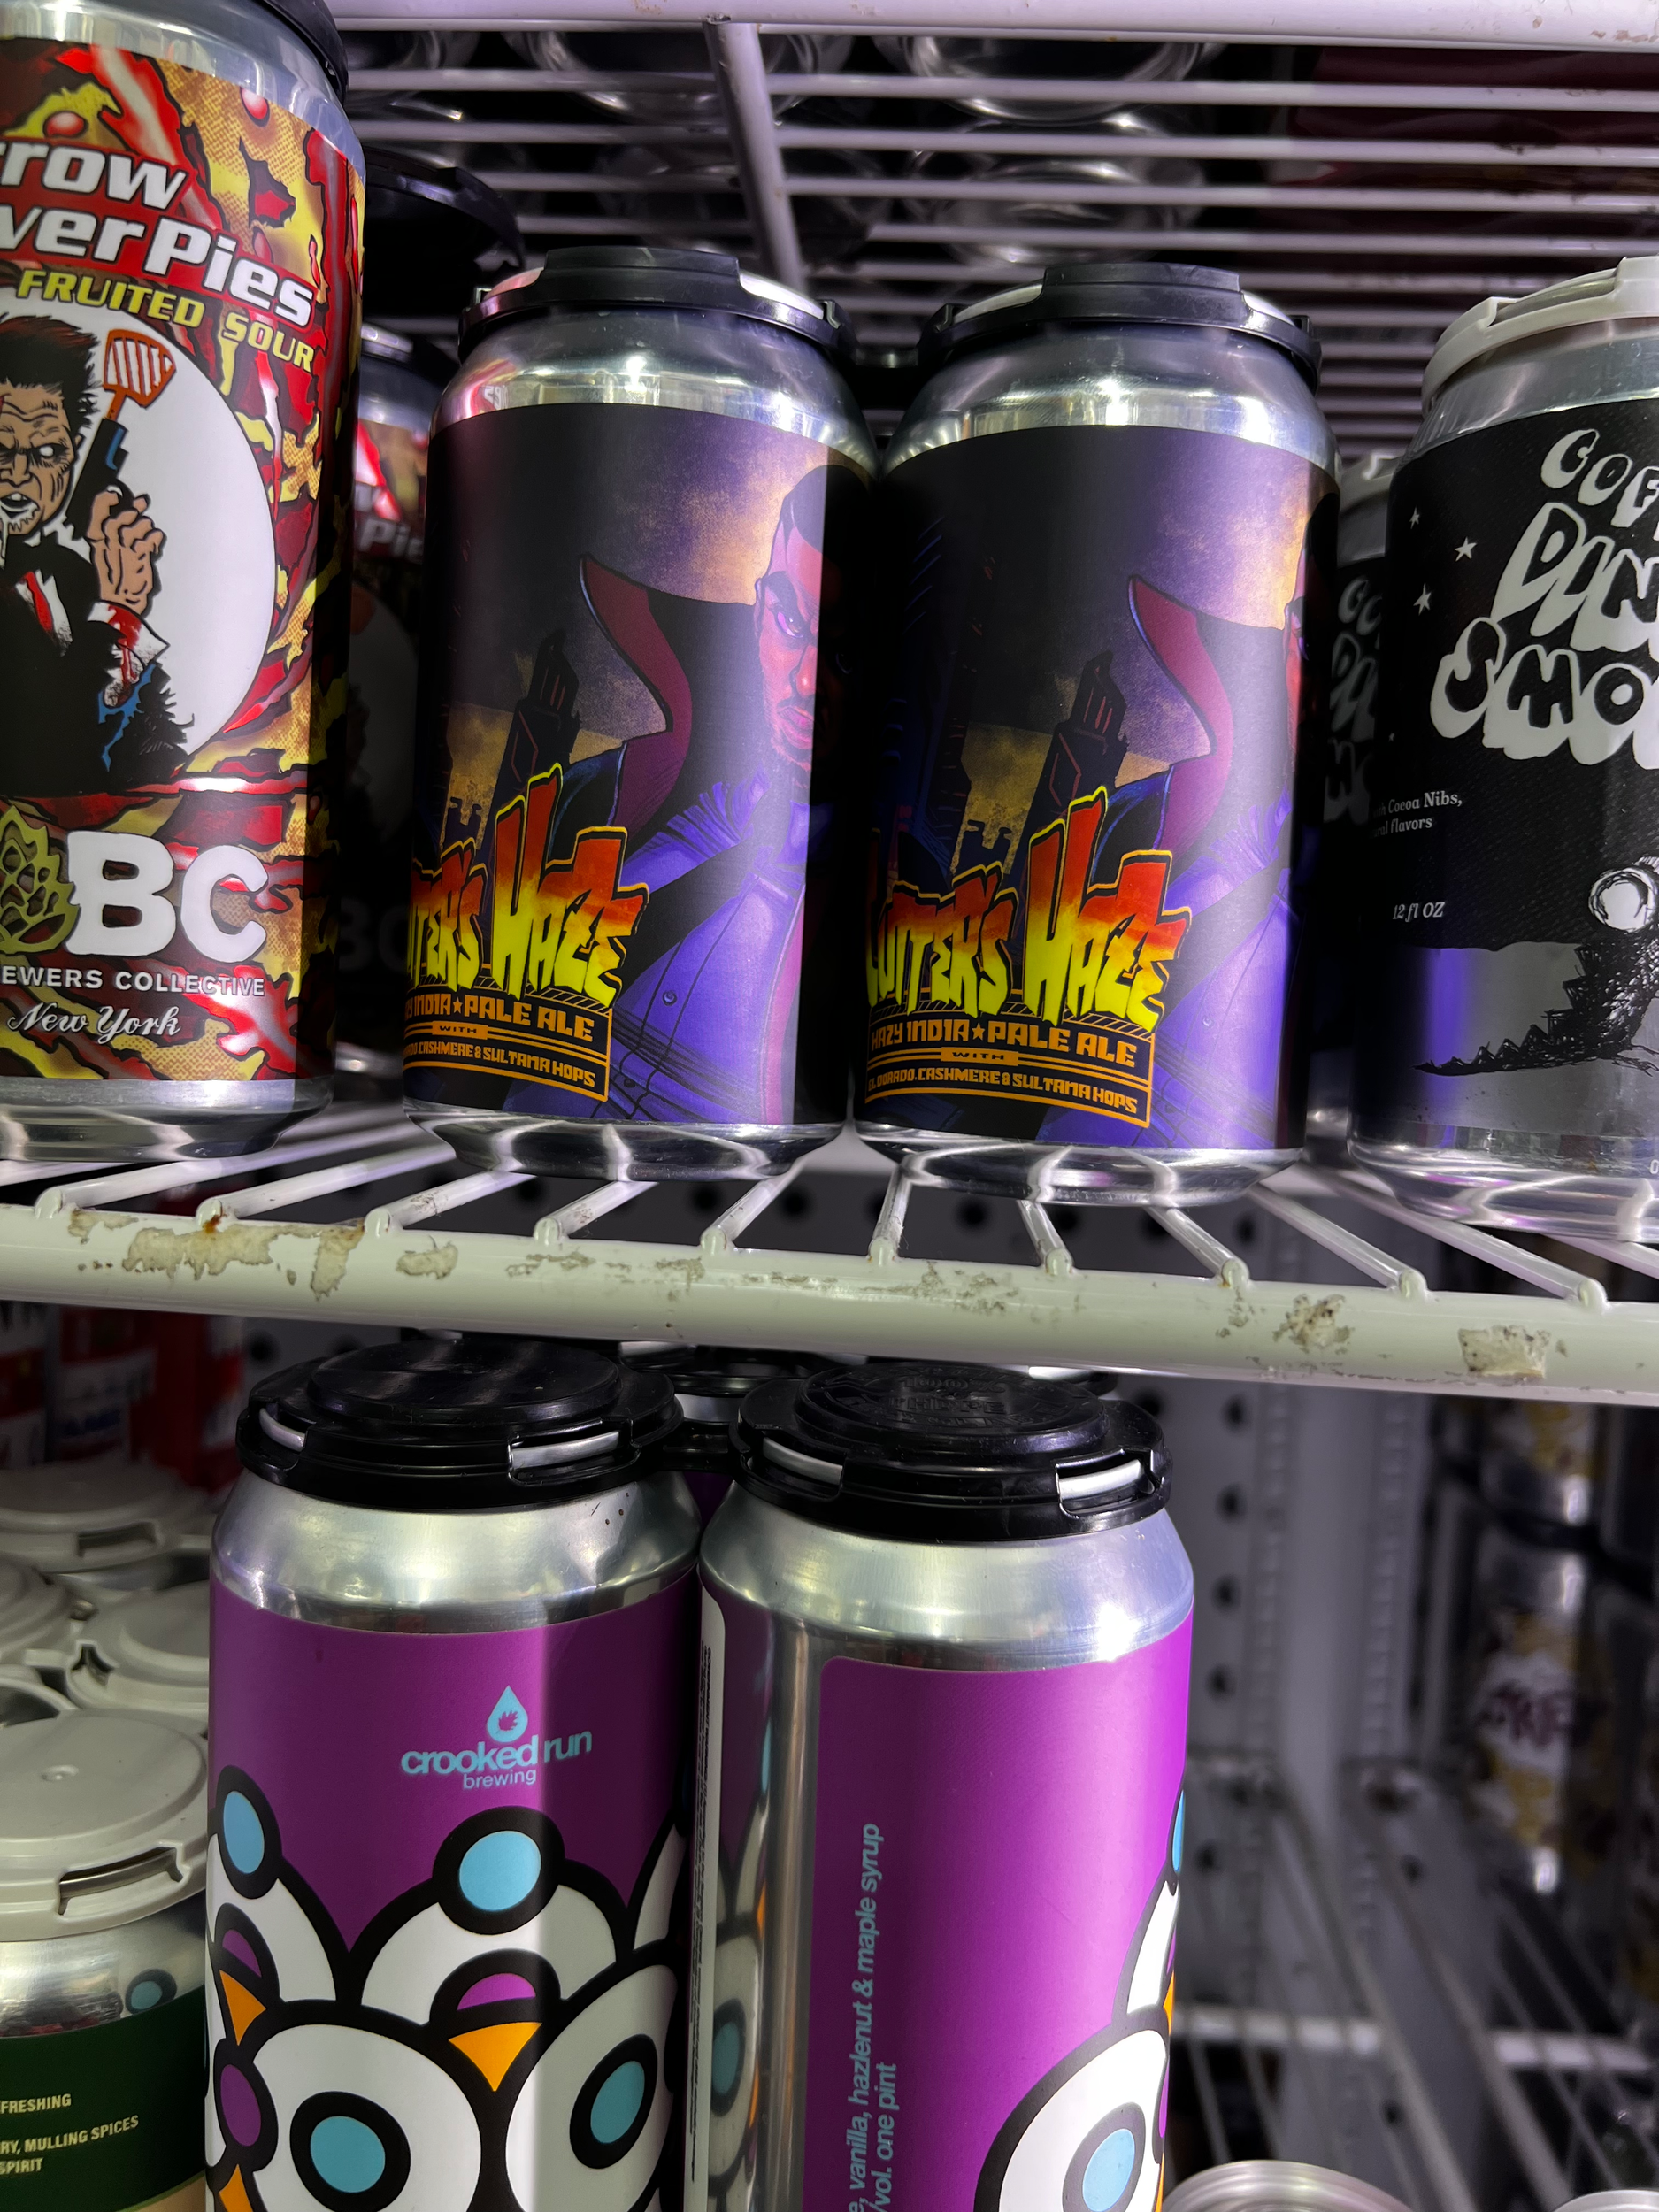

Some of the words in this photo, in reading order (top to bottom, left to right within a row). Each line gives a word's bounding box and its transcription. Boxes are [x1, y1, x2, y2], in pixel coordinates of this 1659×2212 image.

[0, 140, 186, 210] row
[16, 269, 206, 330] FRUITED
[221, 311, 315, 373] SOUR
[1540, 428, 1659, 531] COF
[1490, 502, 1659, 659] DIN
[1430, 617, 1659, 770] SMO
[1387, 797, 1420, 814] Cocoa
[1423, 790, 1463, 809] Nibs,
[1390, 816, 1433, 834] flavors
[65, 830, 268, 963] BC
[492, 763, 649, 1008] HAZE
[1022, 786, 1192, 1033] HAZE
[1392, 903, 1405, 920] 12
[1422, 901, 1446, 918] OZ
[3, 965, 103, 990] EWERS
[114, 971, 265, 997] COLLECTIVE
[6, 1002, 88, 1034] New
[96, 1005, 181, 1045] York
[414, 993, 452, 1017] INDIA
[465, 995, 534, 1026] PALE
[537, 1006, 595, 1042] ALE
[439, 1025, 477, 1034] WITH
[418, 1041, 473, 1058] CASHMERE
[473, 1046, 482, 1060] &
[482, 1046, 551, 1072] SULTANA
[552, 1061, 596, 1088] HOPS
[872, 1024, 902, 1052] HAZY
[906, 1018, 970, 1042] INDIA
[987, 1021, 1070, 1052] PALE
[1077, 1032, 1138, 1068] ALE
[952, 1050, 1005, 1061] WITH
[918, 1067, 1001, 1086] CASHMERE
[1001, 1071, 1011, 1086] &
[1012, 1074, 1090, 1101] SULTANA
[1092, 1087, 1138, 1115] HOPS
[401, 1734, 539, 1775] crooked
[543, 1730, 593, 1763] run
[463, 1769, 537, 1790] brewing
[861, 1823, 885, 1893] syrup
[855, 1897, 880, 1973] maple
[851, 1978, 874, 1998] &
[848, 2001, 873, 2106] hazlenut
[874, 2062, 900, 2110] pint
[24, 2130, 88, 2153] MULLING
[90, 2115, 140, 2141] SPICES
[846, 2111, 872, 2190] vanilla,
[876, 2114, 895, 2161] one
